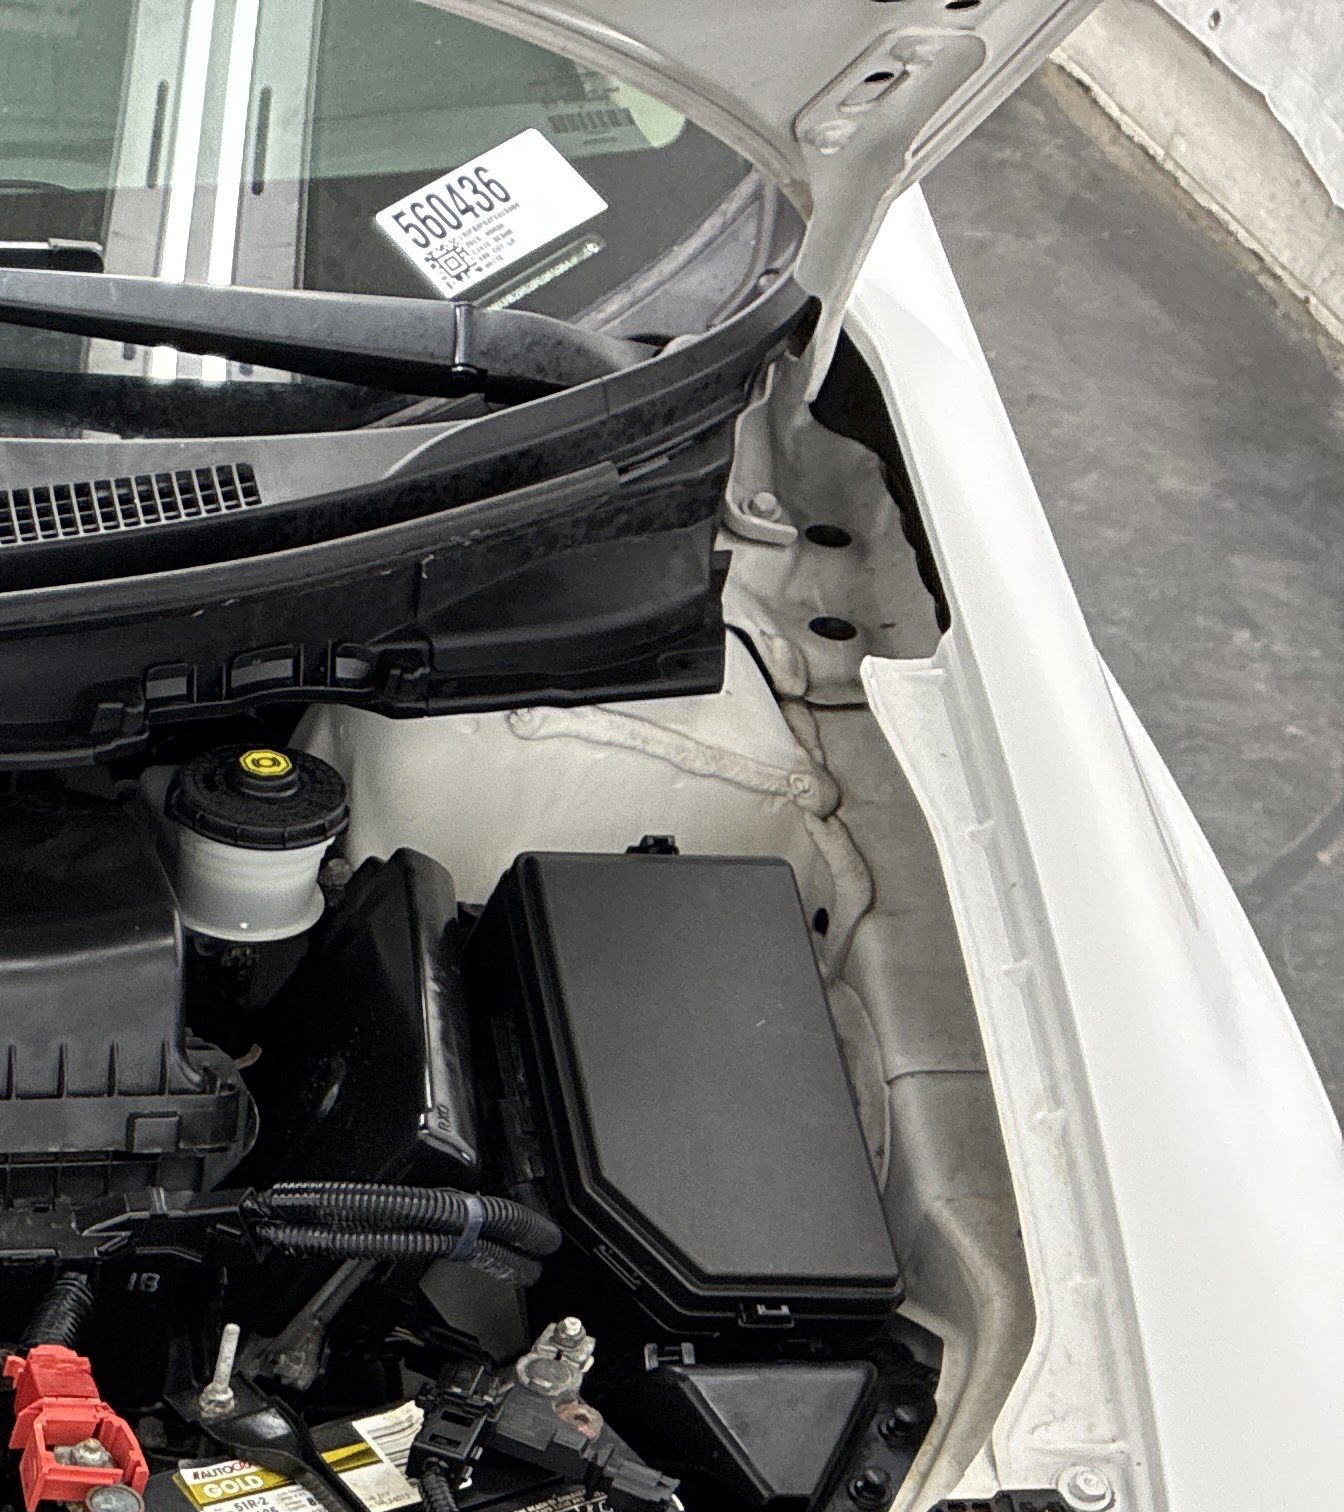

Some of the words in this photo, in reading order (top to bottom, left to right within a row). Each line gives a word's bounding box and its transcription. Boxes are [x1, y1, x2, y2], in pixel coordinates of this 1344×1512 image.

[392, 167, 511, 248] 560436
[203, 1475, 264, 1498] GOLD
[234, 1496, 269, 1512] 51R-2
